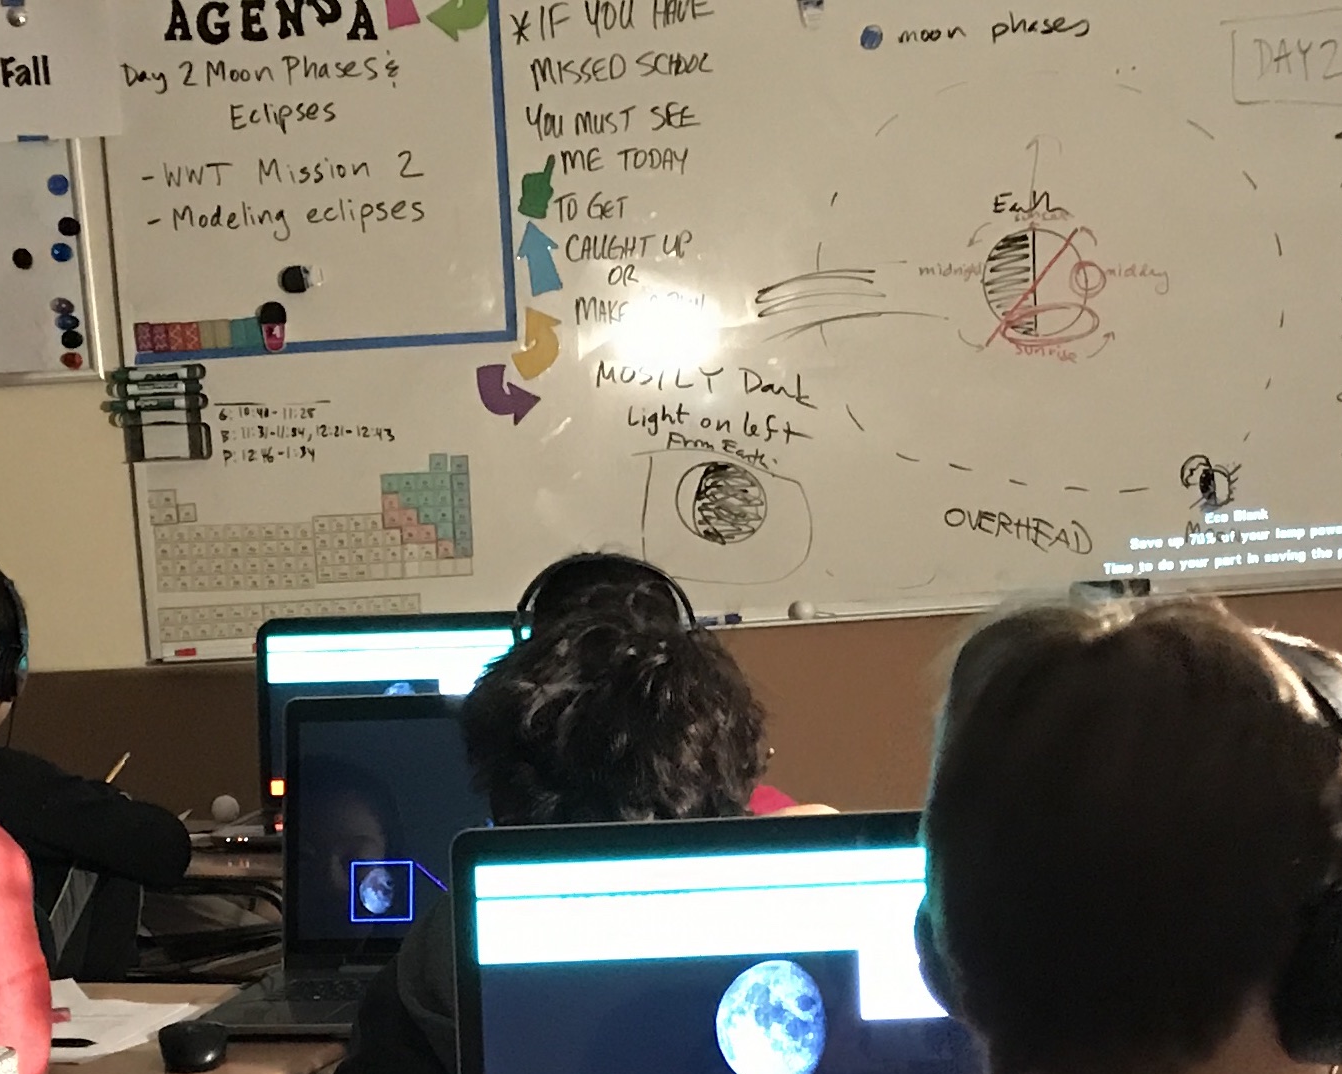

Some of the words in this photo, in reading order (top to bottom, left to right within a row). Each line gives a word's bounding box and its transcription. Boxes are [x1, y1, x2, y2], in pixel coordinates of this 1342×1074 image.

[897, 25, 967, 43] moon
[991, 11, 1090, 43] phases
[0, 55, 51, 88] Fall
[120, 61, 168, 94] Day
[179, 60, 198, 87] 2
[206, 60, 274, 88] Moon
[282, 54, 379, 86] Phases
[530, 53, 626, 92] MISSED
[635, 51, 714, 78] SCHOOL
[1253, 38, 1313, 81] DAY
[230, 101, 336, 134] Eclipses
[575, 105, 637, 137] MUST
[650, 101, 701, 132] SEE
[259, 157, 371, 186] Mission
[398, 150, 425, 179] 2
[560, 148, 604, 175] ME
[617, 147, 689, 175] TODAY
[173, 203, 291, 242] Modeling
[307, 198, 425, 233] eclipses
[587, 191, 628, 220] GET
[565, 233, 656, 264] CAUGHT
[662, 228, 693, 259] UP
[608, 264, 639, 287] OR
[628, 402, 690, 436] Light
[700, 416, 730, 433] on
[744, 411, 813, 445] left
[944, 508, 1093, 555] OVERHEAD
[1103, 561, 1134, 575] Time
